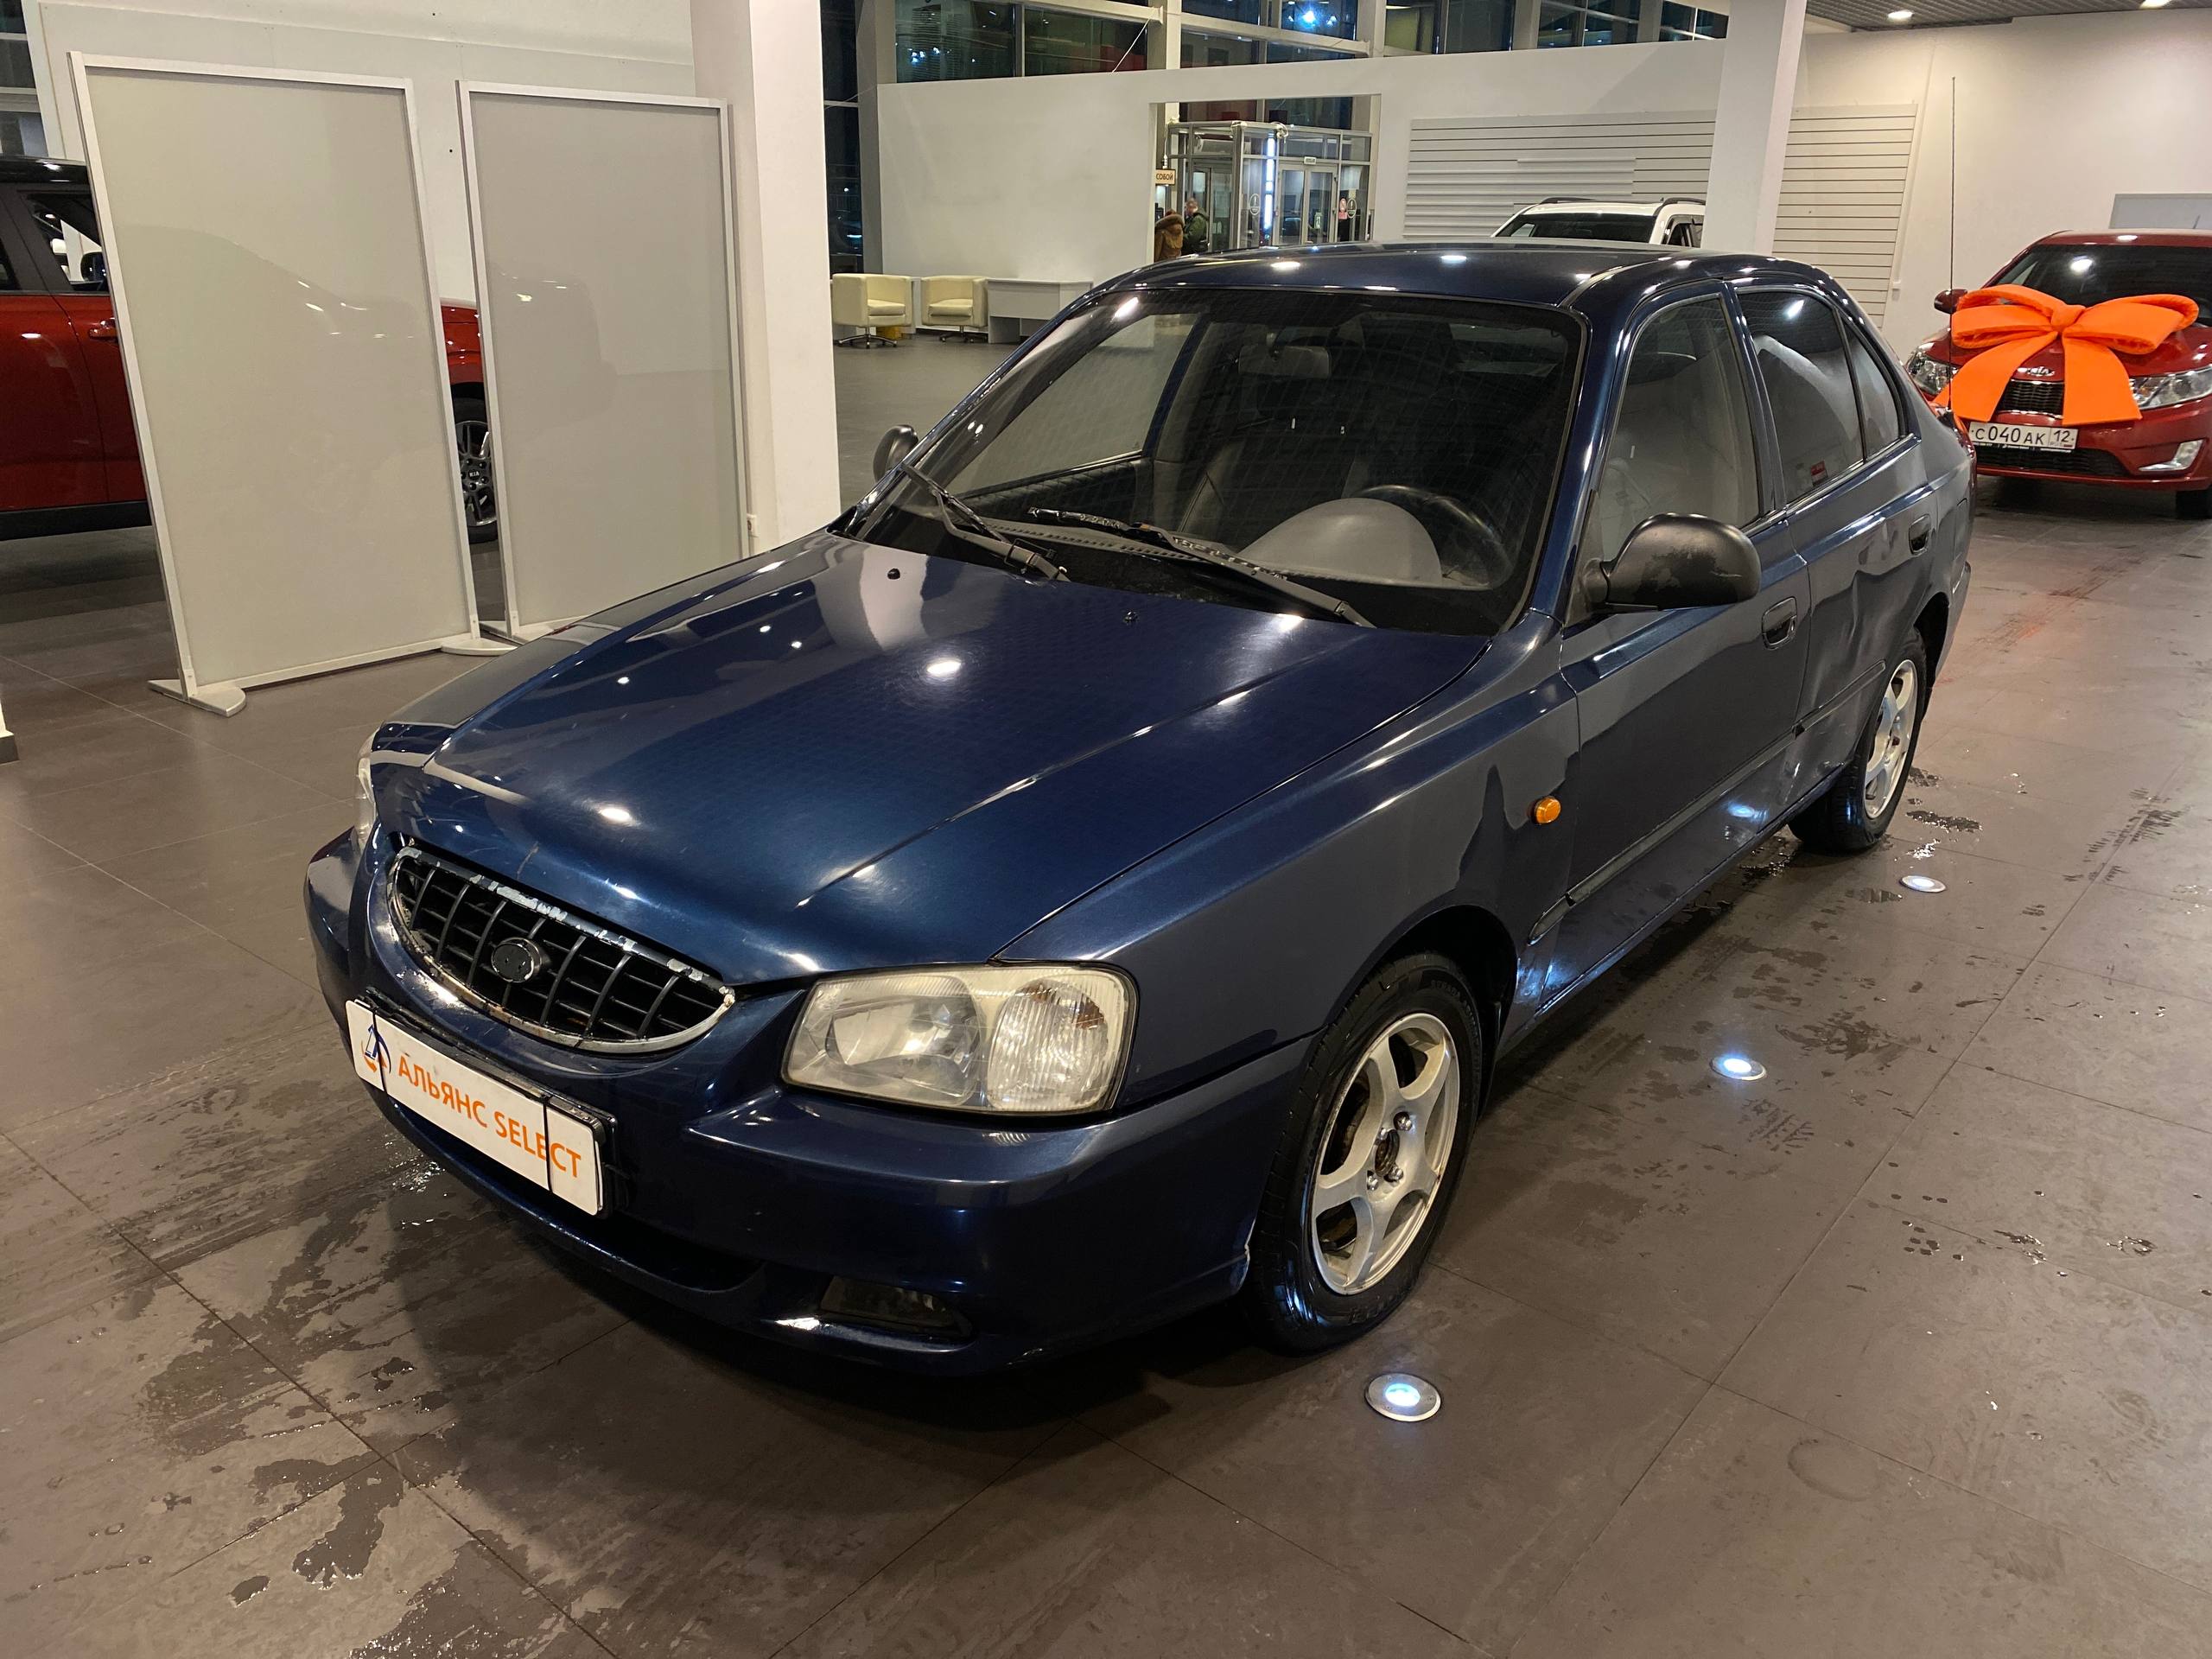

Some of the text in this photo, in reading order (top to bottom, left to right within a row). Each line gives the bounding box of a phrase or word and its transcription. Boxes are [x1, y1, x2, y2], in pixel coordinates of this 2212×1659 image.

[2053, 429, 2070, 442] 12
[398, 1055, 582, 1178] АЛЬЯНС SELECT
